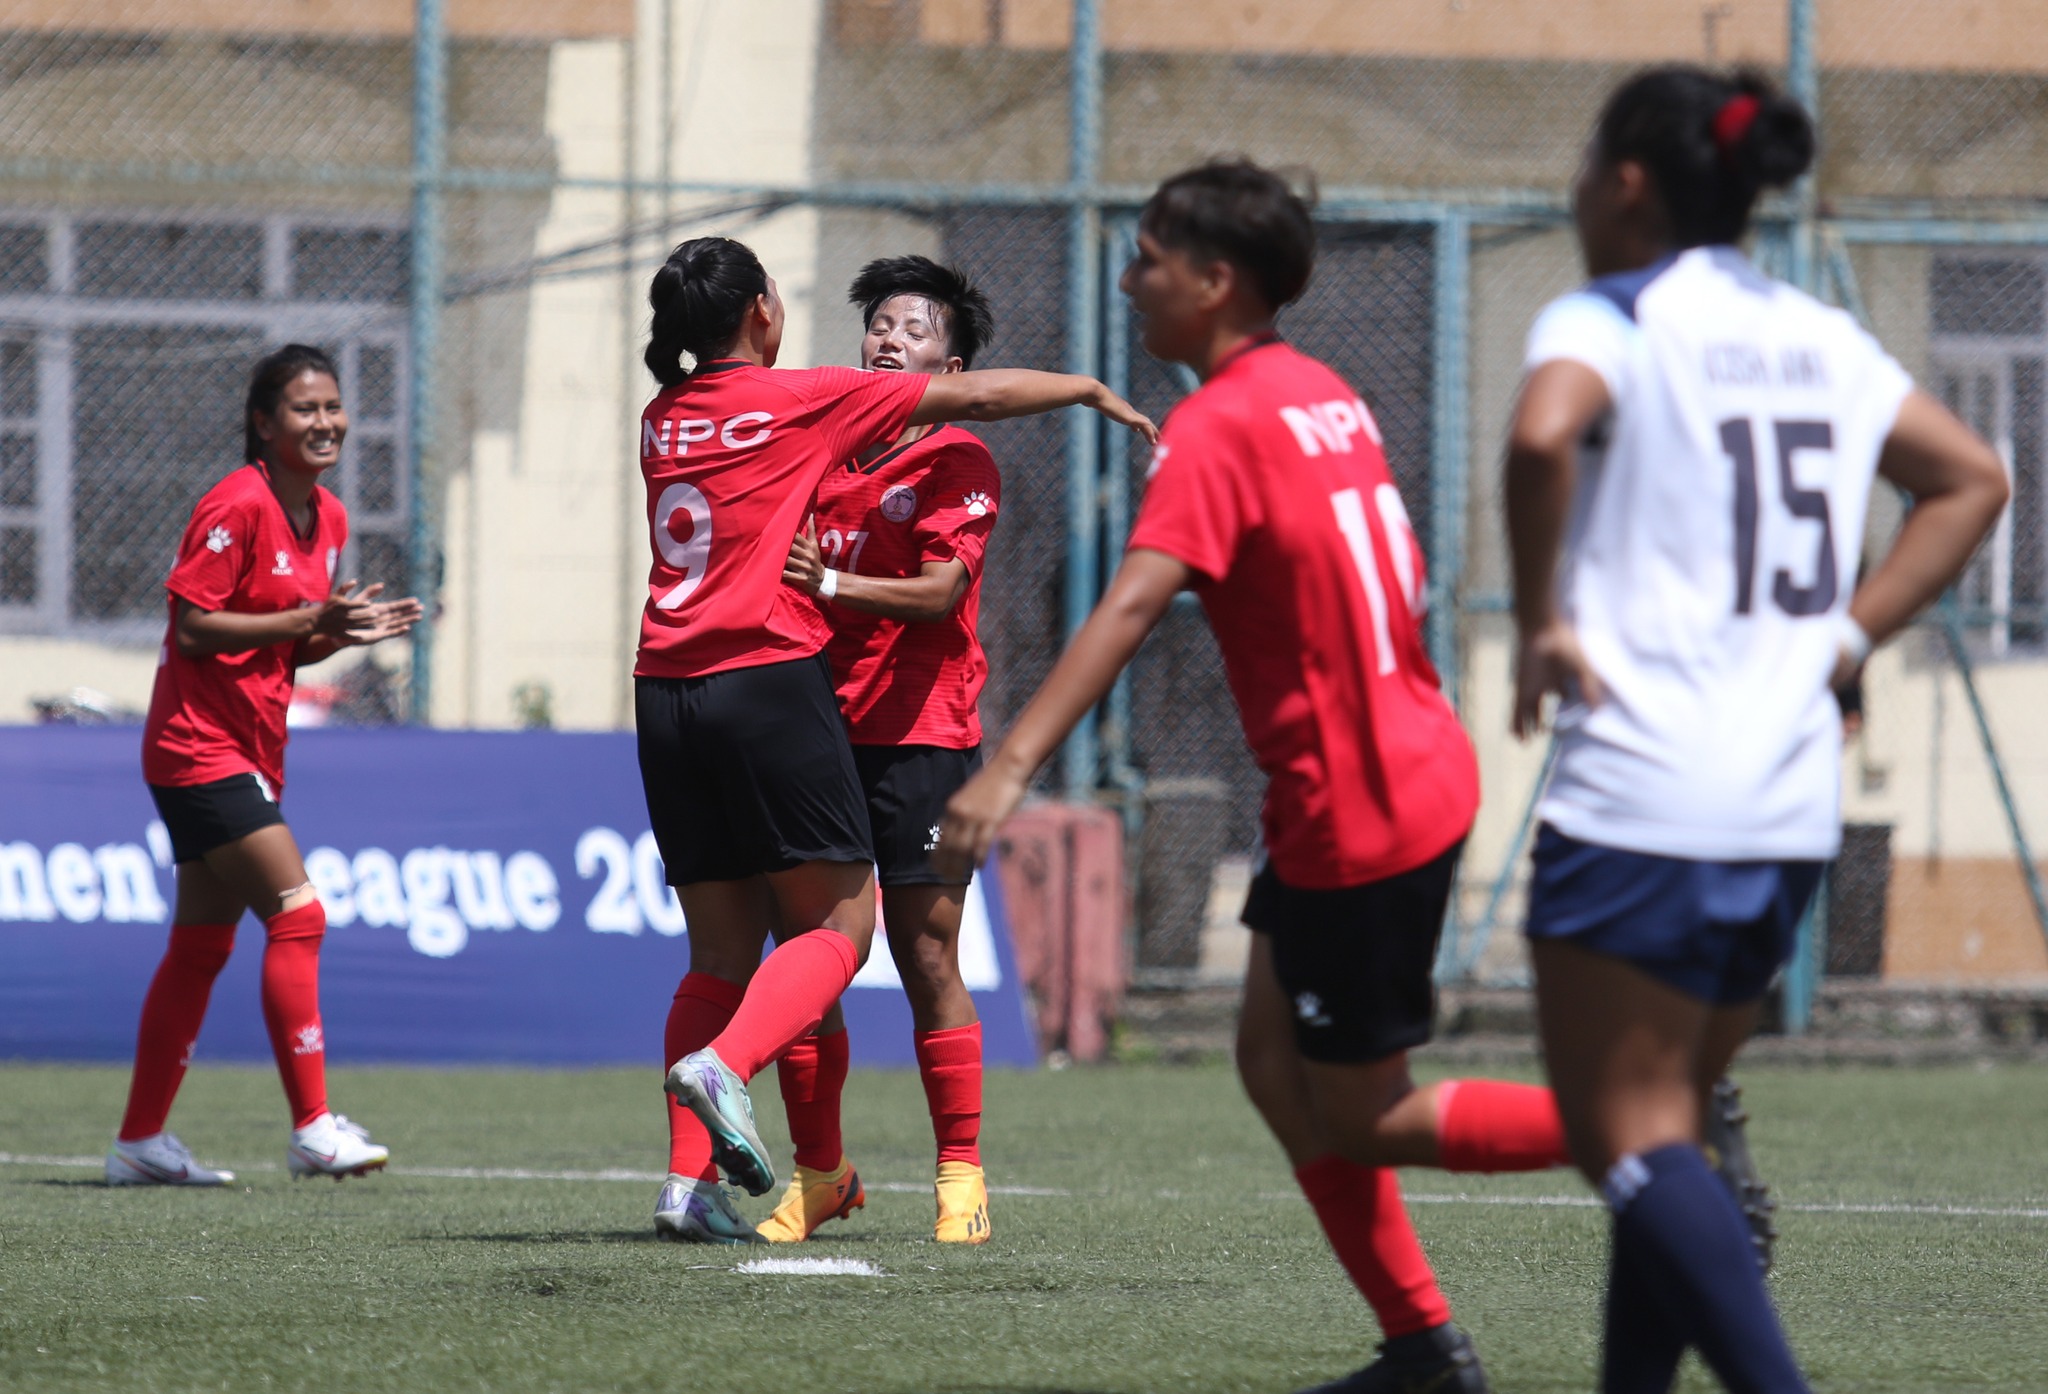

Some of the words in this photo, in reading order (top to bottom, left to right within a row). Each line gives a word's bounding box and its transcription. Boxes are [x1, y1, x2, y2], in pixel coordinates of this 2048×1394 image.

[643, 411, 774, 457] NPC
[654, 482, 713, 609] 9
[821, 529, 870, 574] 27
[1718, 416, 1837, 618] 15
[1330, 482, 1429, 676] 10
[301, 845, 561, 958] eague
